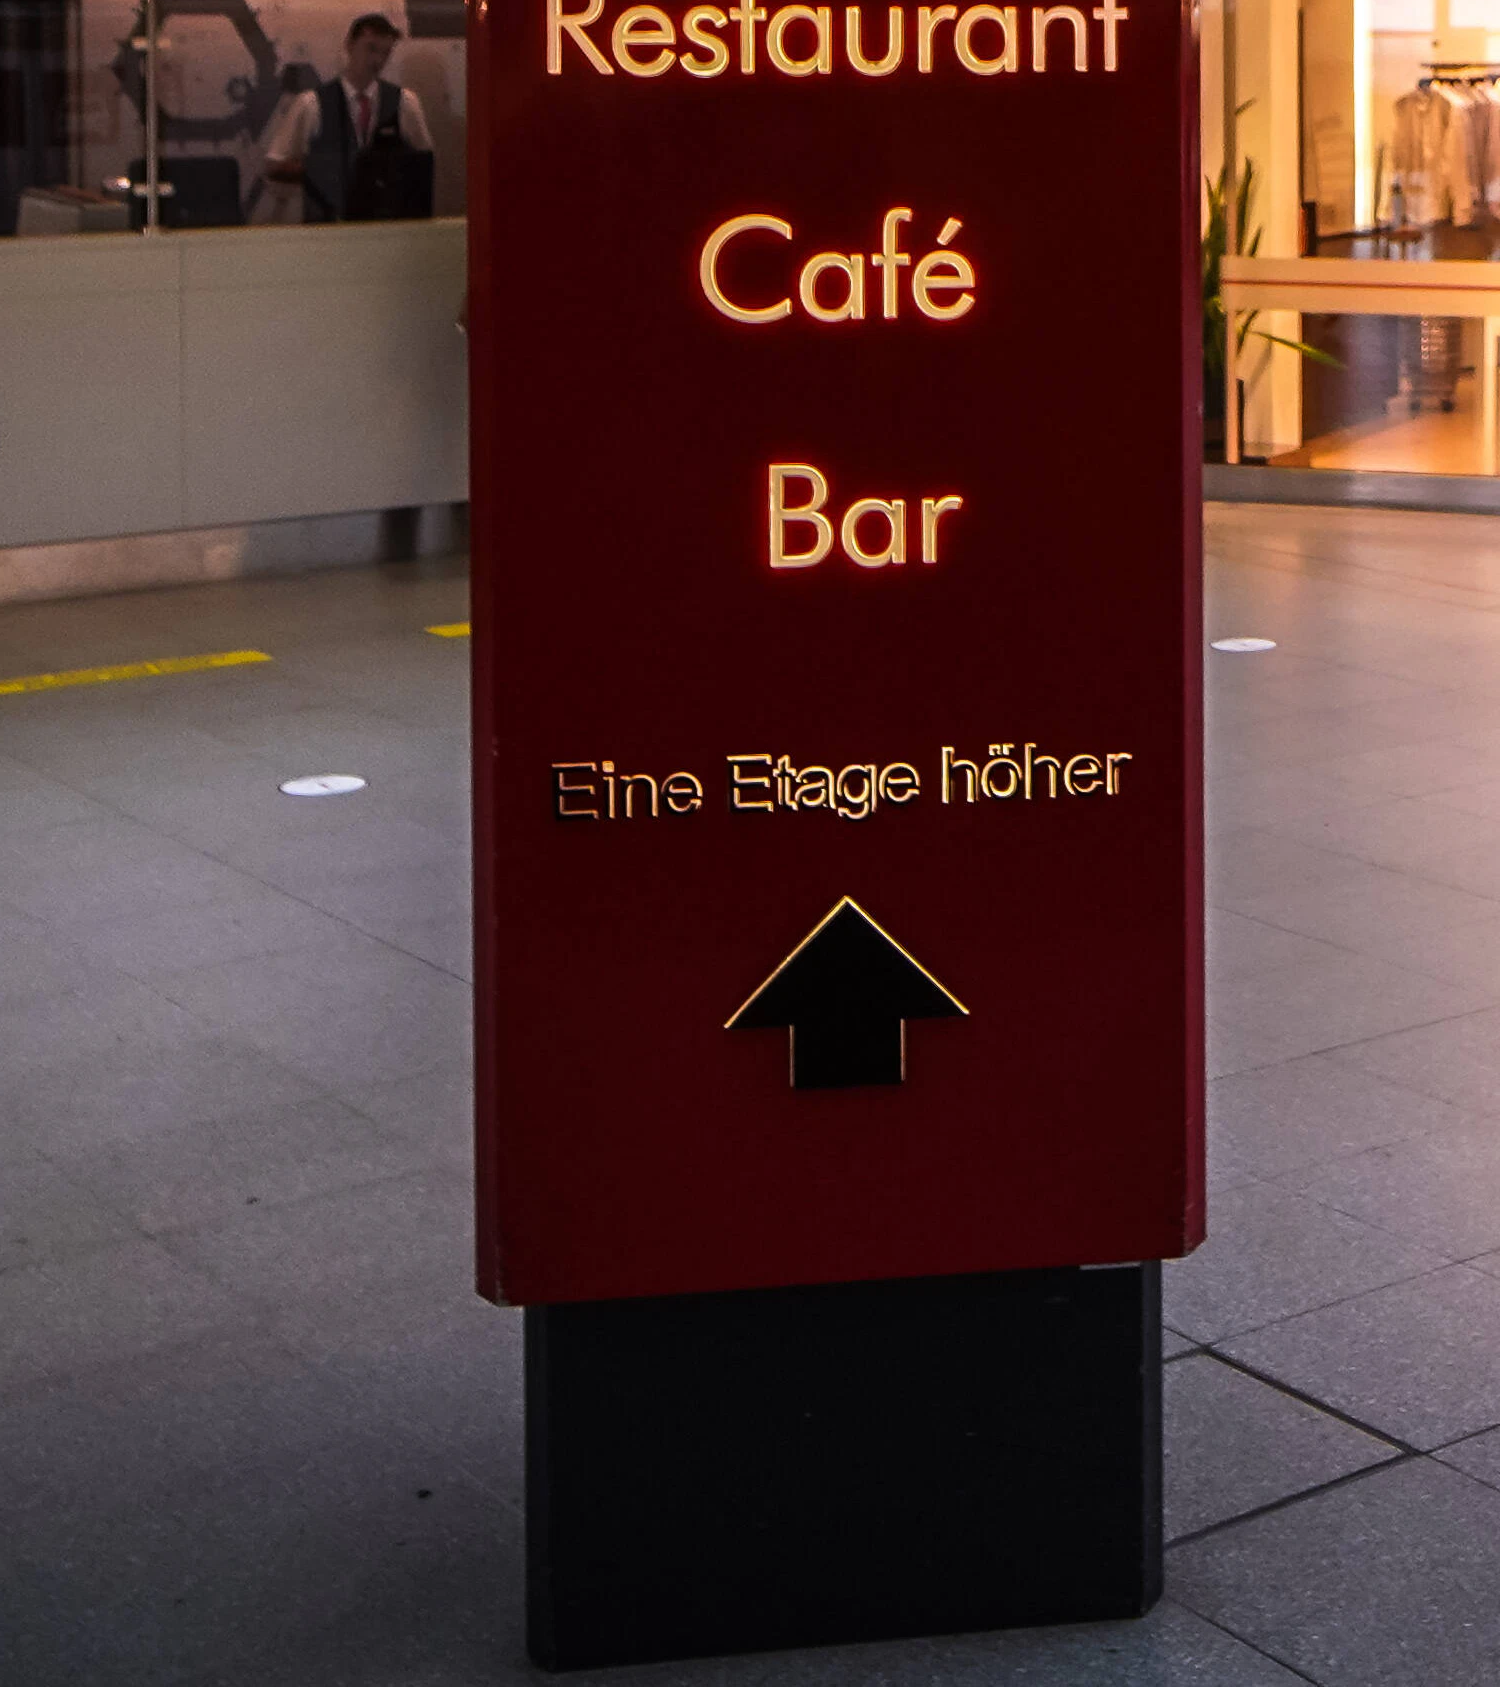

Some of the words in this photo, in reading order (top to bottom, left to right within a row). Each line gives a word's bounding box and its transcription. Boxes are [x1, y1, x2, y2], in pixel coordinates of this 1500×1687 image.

[699, 207, 977, 324] Café
[768, 462, 964, 568] Bar
[551, 761, 703, 820] Eine
[726, 753, 920, 820] Etage
[941, 743, 1134, 805] höher
